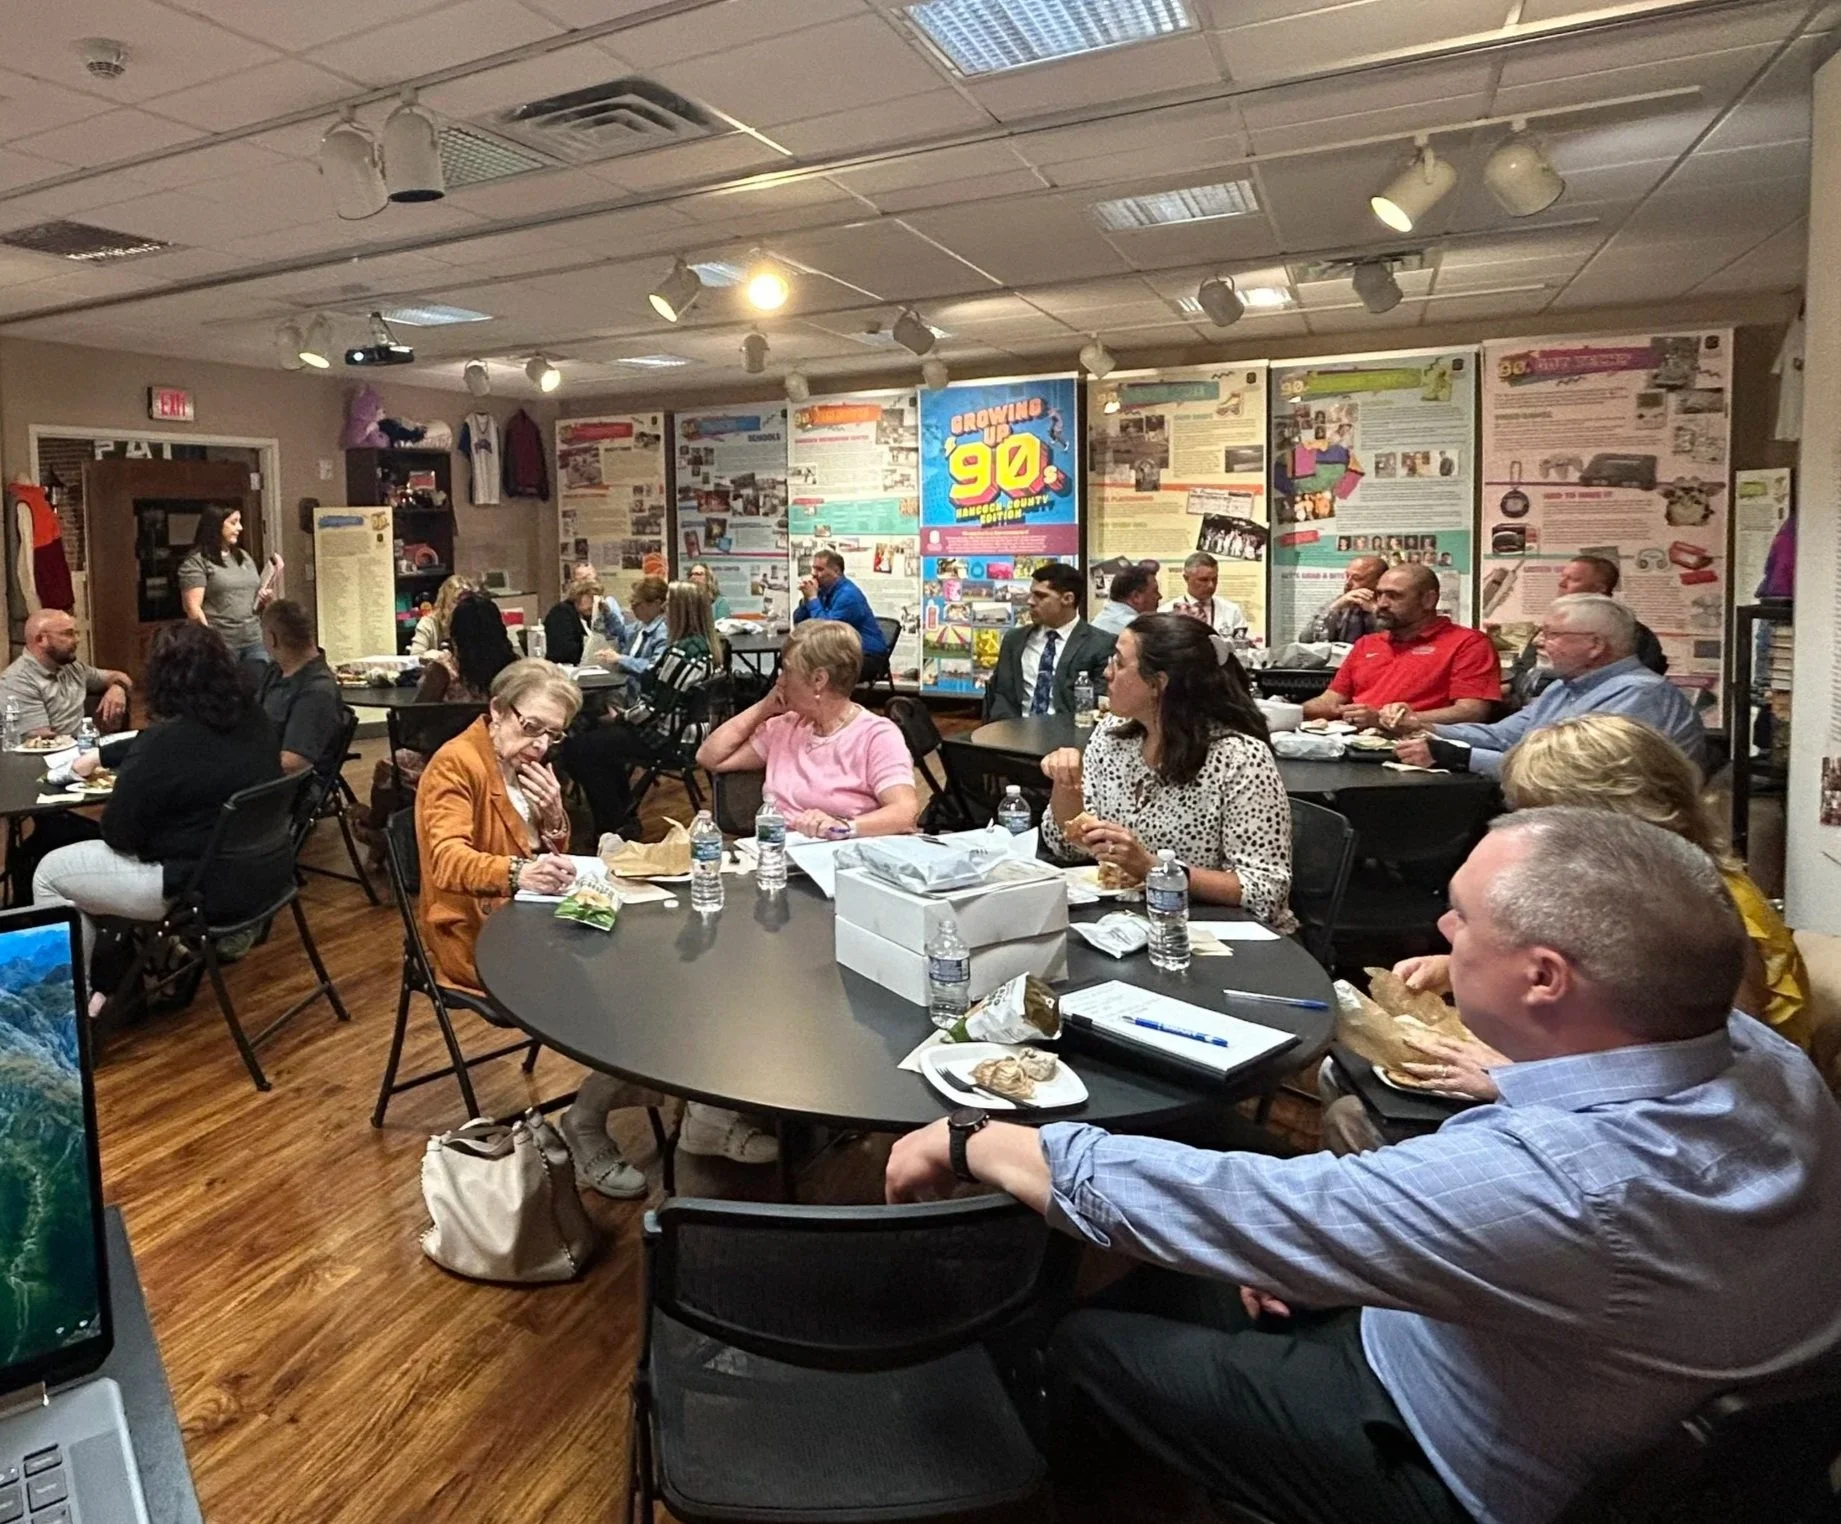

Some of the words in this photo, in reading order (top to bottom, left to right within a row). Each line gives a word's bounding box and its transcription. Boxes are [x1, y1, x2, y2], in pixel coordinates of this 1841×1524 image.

[160, 391, 187, 416] EXIT
[951, 398, 1043, 435] GROWING
[984, 423, 1011, 447] UP
[956, 502, 1002, 519] HANCOCK
[1007, 495, 1049, 509] COUNTY
[980, 508, 1022, 524] EDITION
